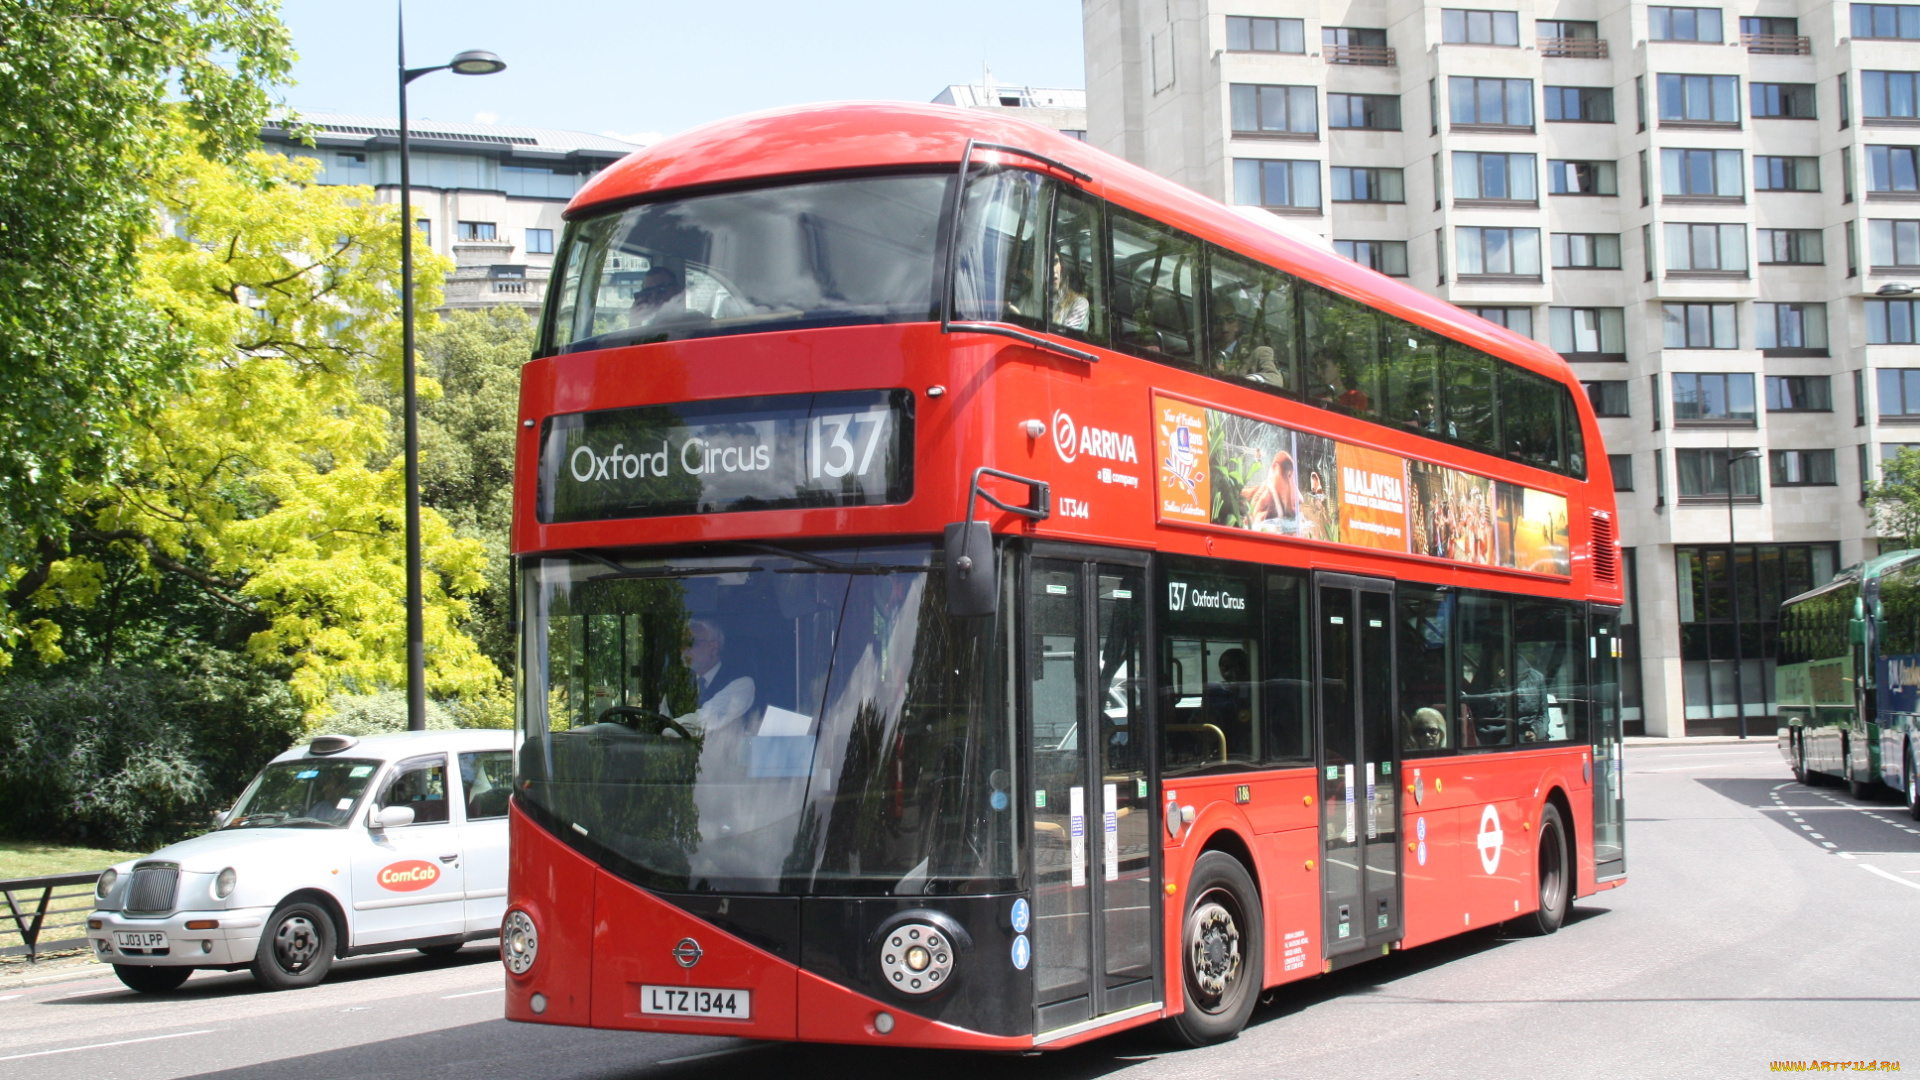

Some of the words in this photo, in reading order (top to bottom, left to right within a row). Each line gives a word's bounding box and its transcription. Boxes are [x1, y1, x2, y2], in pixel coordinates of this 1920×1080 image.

[811, 410, 888, 479] 137
[1080, 426, 1138, 464] ARRIVA
[571, 440, 668, 482] Oxford
[680, 437, 770, 476] Circus
[1343, 466, 1403, 503] MALAYSIA
[1059, 497, 1088, 519] LT344
[1168, 582, 1188, 611] 137
[1191, 588, 1220, 608] Oxford
[1221, 591, 1245, 610] Circus
[382, 866, 436, 884] ComCab
[118, 933, 142, 946] LJ03
[142, 933, 163, 946] LPP
[652, 989, 689, 1012] LTZ
[694, 991, 737, 1014] 1344
